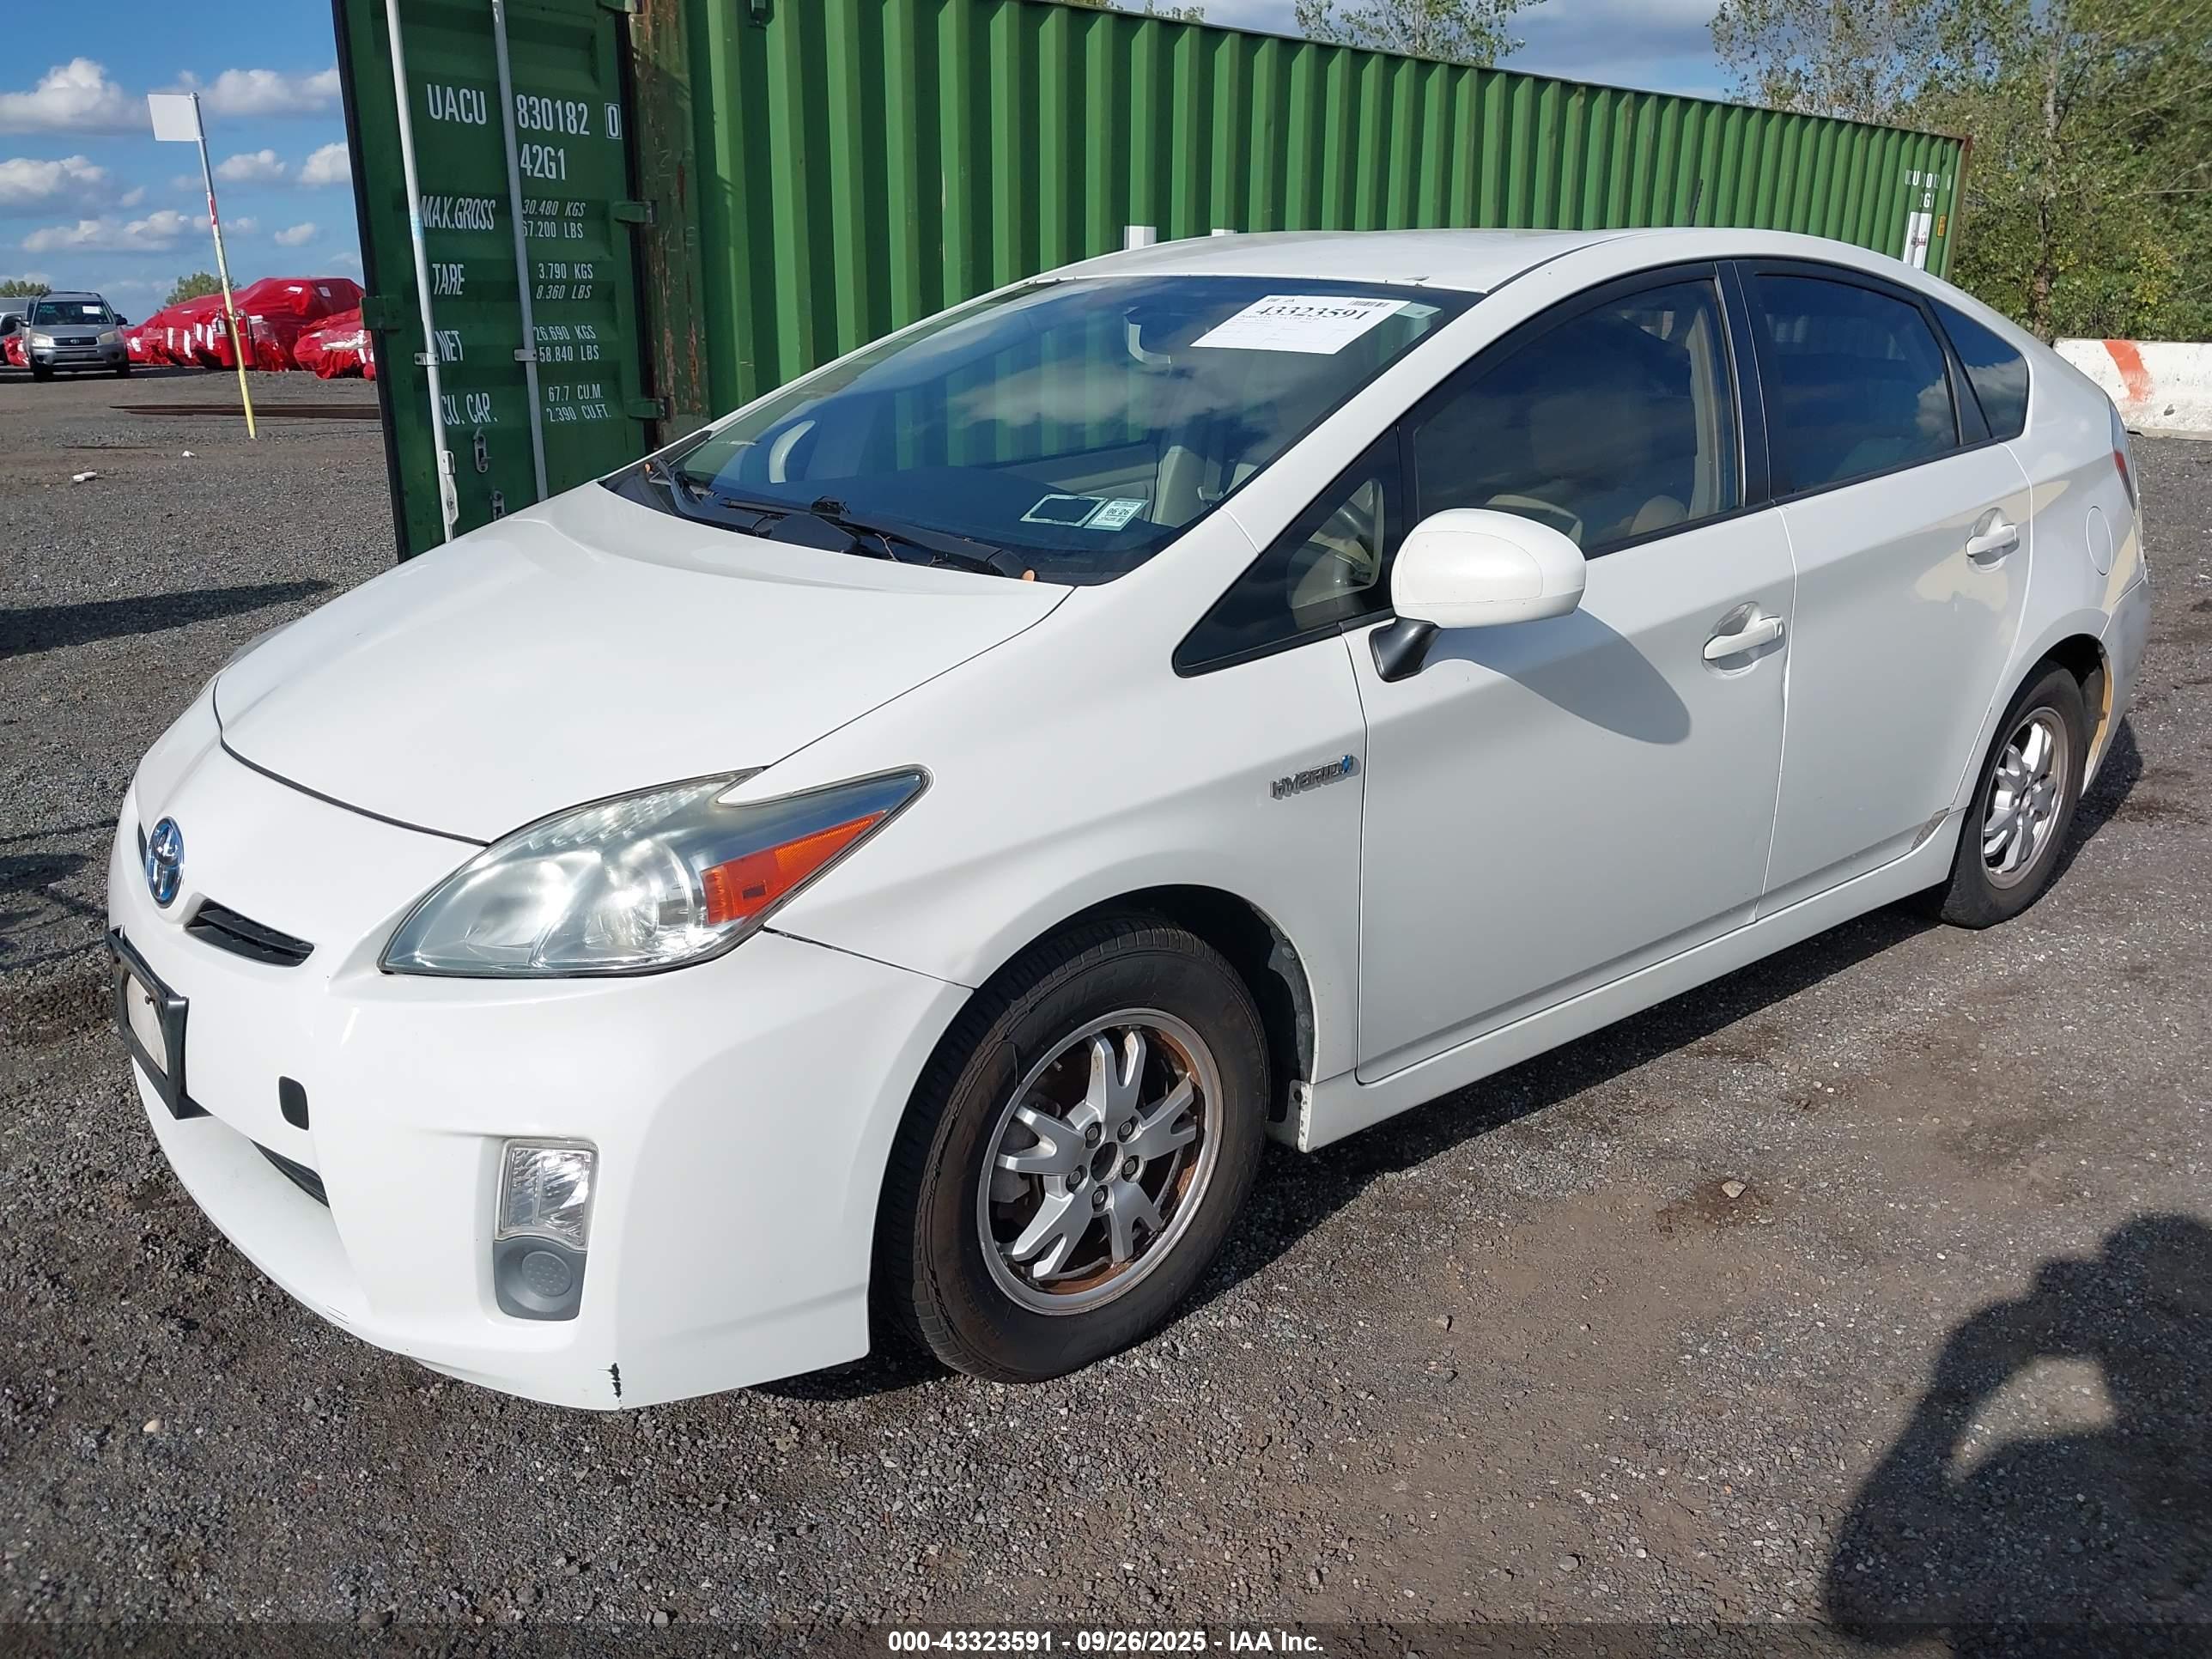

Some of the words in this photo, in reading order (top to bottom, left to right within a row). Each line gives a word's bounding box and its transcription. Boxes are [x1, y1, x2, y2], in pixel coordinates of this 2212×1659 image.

[427, 83, 487, 125] UACU
[516, 94, 591, 136] 830182
[606, 106, 621, 138] 0
[520, 143, 567, 180] 42G1
[522, 198, 559, 216] 30.480
[564, 201, 586, 217] KGS
[563, 222, 584, 239] LBS
[432, 263, 465, 295] TARE
[538, 262, 567, 279] 3.790
[574, 263, 593, 279] KGS
[536, 284, 566, 300] 8.360
[571, 284, 592, 299] LBS
[1255, 305, 1370, 320] 43323591
[532, 325, 571, 341] 26.690
[574, 325, 597, 340] KGS
[434, 330, 464, 362] NET
[538, 345, 574, 362] 58.840
[580, 344, 599, 361] LBS
[548, 385, 569, 402] 67.7
[577, 383, 604, 400] CU.M.
[441, 394, 465, 426] CU.
[466, 392, 498, 423] CAP.
[545, 406, 577, 422] 2.390
[580, 404, 612, 420] CU.FT.
[1270, 761, 1343, 799] HYBRID
